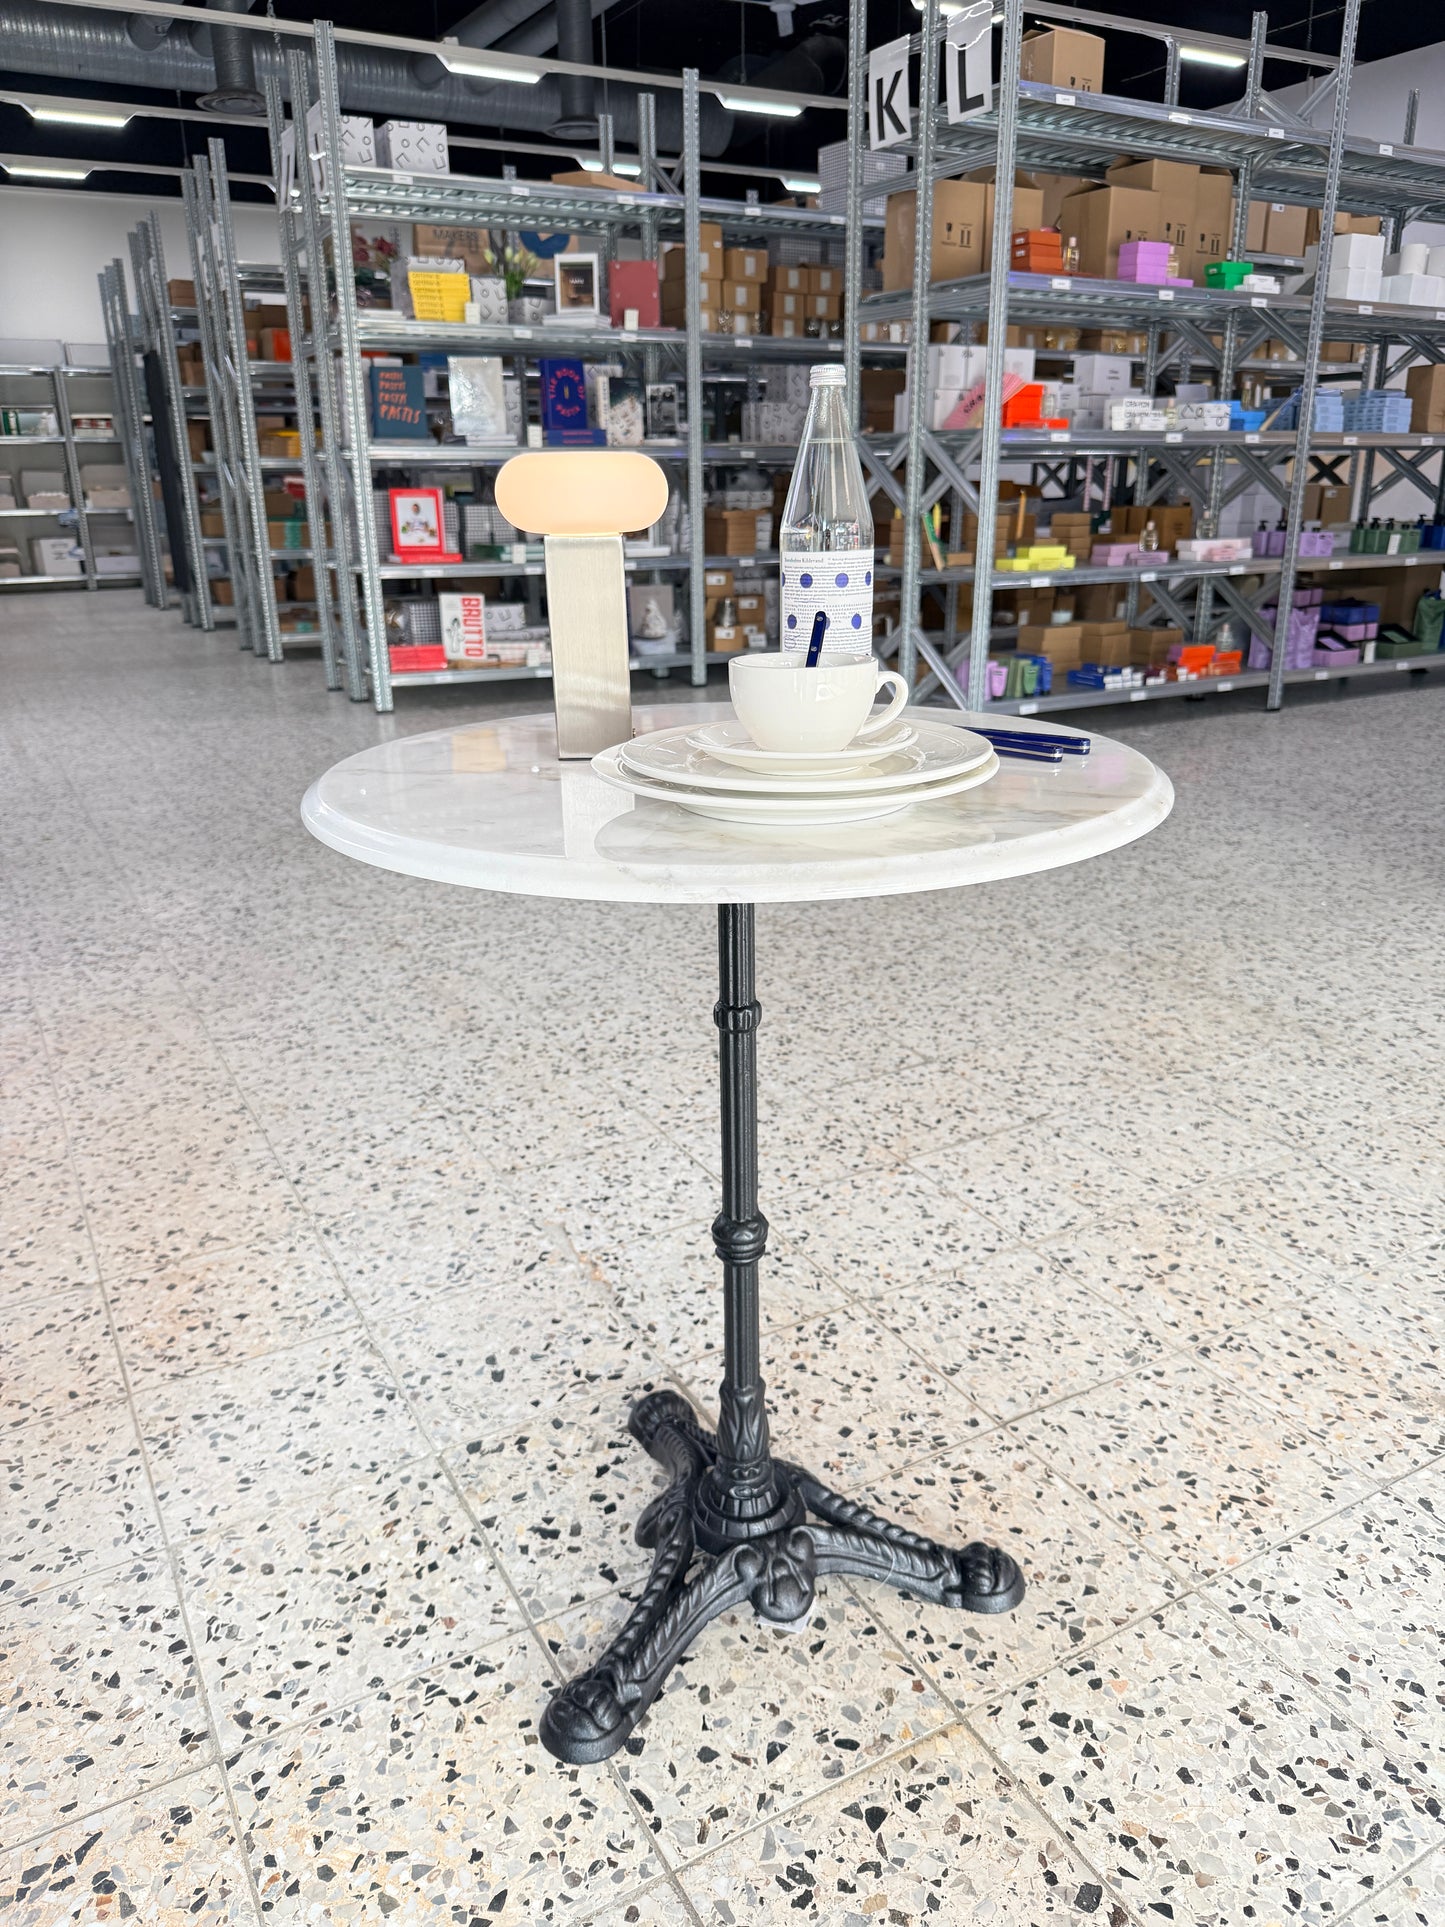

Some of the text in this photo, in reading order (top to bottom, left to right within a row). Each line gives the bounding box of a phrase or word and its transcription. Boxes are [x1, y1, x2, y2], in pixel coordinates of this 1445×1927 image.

[876, 69, 907, 142] K
[957, 43, 985, 114] L
[549, 377, 557, 399] THE
[555, 367, 580, 383] BOOK
[577, 385, 585, 400] OF
[461, 597, 484, 657] BRUTTO
